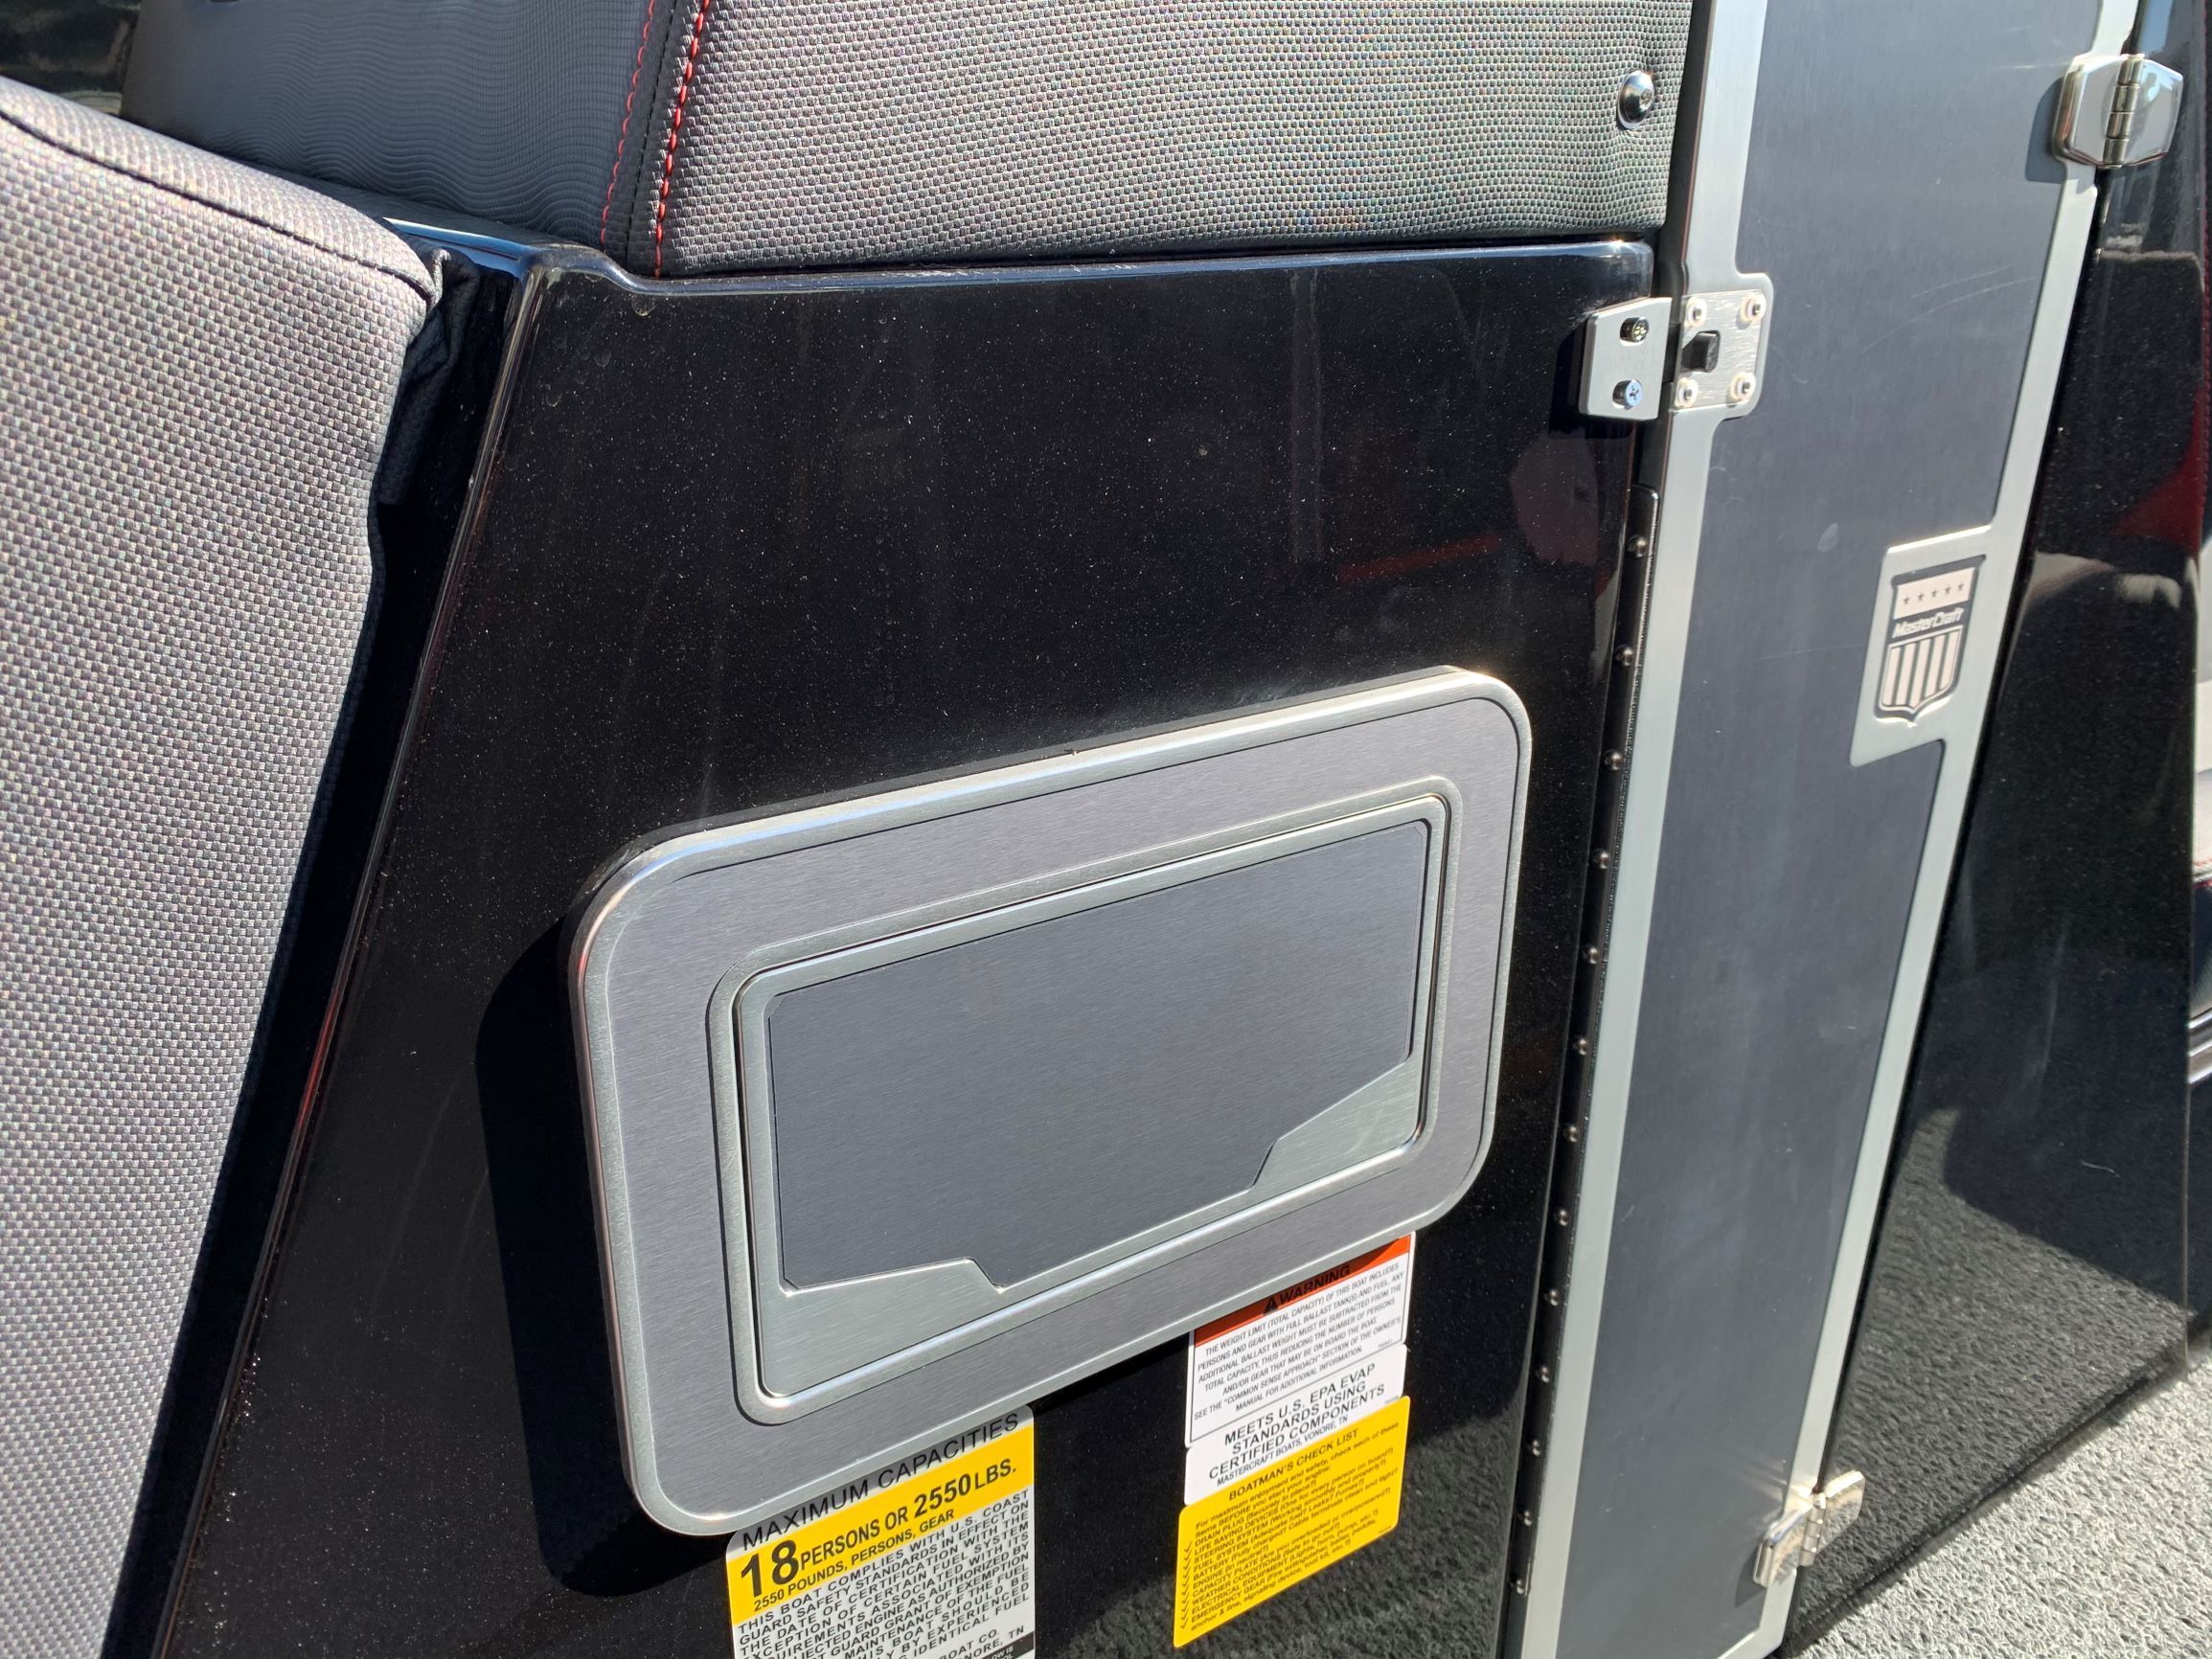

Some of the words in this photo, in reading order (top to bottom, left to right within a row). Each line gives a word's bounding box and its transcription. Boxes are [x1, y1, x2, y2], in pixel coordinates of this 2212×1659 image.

[1208, 1432, 1285, 1481] CERTIFIED
[1288, 1382, 1384, 1441] COMPONENTS
[1217, 1450, 1273, 1487] MASTERCRAFT
[1275, 1436, 1302, 1457] BOATS,
[1338, 1413, 1348, 1425] TN
[1224, 1411, 1273, 1446] MEETS
[1278, 1396, 1305, 1420] U.S.
[1310, 1380, 1336, 1404] EPA
[1339, 1361, 1376, 1389] EVAP
[1232, 1401, 1319, 1455] STANDARDS
[1324, 1379, 1366, 1410] USING
[742, 1478, 869, 1551] MAXIMUM
[878, 1413, 1018, 1489] CAPACITIES
[1229, 1460, 1293, 1501] BOATMAN'S
[1296, 1440, 1334, 1466] CHECK
[1336, 1427, 1357, 1446] LIST
[737, 1609, 773, 1635] THIS
[779, 1587, 819, 1616] BOAT
[827, 1548, 903, 1593] COMPLIES
[908, 1528, 945, 1554] WITH
[948, 1512, 976, 1534] U.S.
[981, 1489, 1028, 1519] COAST
[739, 1612, 792, 1647] GUARD
[796, 1584, 851, 1619] SAFETY
[855, 1543, 937, 1591] STANDARDS
[940, 1534, 954, 1550] IN
[957, 1511, 1005, 1541] EFFECT
[1010, 1499, 1029, 1516] ON
[741, 1539, 799, 1599] 18
[801, 1519, 880, 1571] PERSONS
[885, 1506, 908, 1531] OR
[914, 1473, 971, 1519] 2550
[974, 1458, 1016, 1490] LBS.
[753, 1587, 785, 1613] 2550
[787, 1557, 847, 1597] POUNDS,
[851, 1526, 915, 1567] PERSONS,
[919, 1508, 954, 1534] GEAR
[837, 1603, 856, 1621] OF
[863, 1569, 926, 1608] CERTAIN
[932, 1550, 968, 1575] FUEL
[973, 1519, 1029, 1555] SYSTEM
[871, 1562, 963, 1616] ASSOCIATED
[968, 1543, 1002, 1568] WITH
[1008, 1530, 1029, 1548] ITS
[740, 1634, 770, 1657] THE
[776, 1612, 816, 1640] DATE
[822, 1600, 841, 1618] OF
[848, 1543, 958, 1605] CERTIFICATION
[963, 1524, 997, 1549] WITH
[1002, 1510, 1029, 1530] THE
[831, 1625, 879, 1657] GUARD
[884, 1601, 928, 1630] GRANT
[934, 1589, 951, 1605] OF
[955, 1550, 1029, 1595] EXEMPTION
[844, 1604, 942, 1659] MAINTENANCE
[946, 1594, 963, 1609] OF
[969, 1579, 992, 1599] THE
[996, 1560, 1029, 1584] FUEL
[855, 1602, 904, 1634] ENGINE
[907, 1592, 925, 1608] AS
[928, 1550, 1009, 1598] AUTHORIZED
[1012, 1540, 1029, 1556] BY
[891, 1620, 931, 1648] BOAT
[941, 1583, 1003, 1623] SHOULD
[1010, 1570, 1029, 1587] BE
[901, 1637, 919, 1653] BY
[926, 1579, 1029, 1640] EXPERIENCED
[913, 1613, 985, 1658] IDENTICAL
[994, 1590, 1029, 1616] FUEL
[1009, 1625, 1024, 1639] TN
